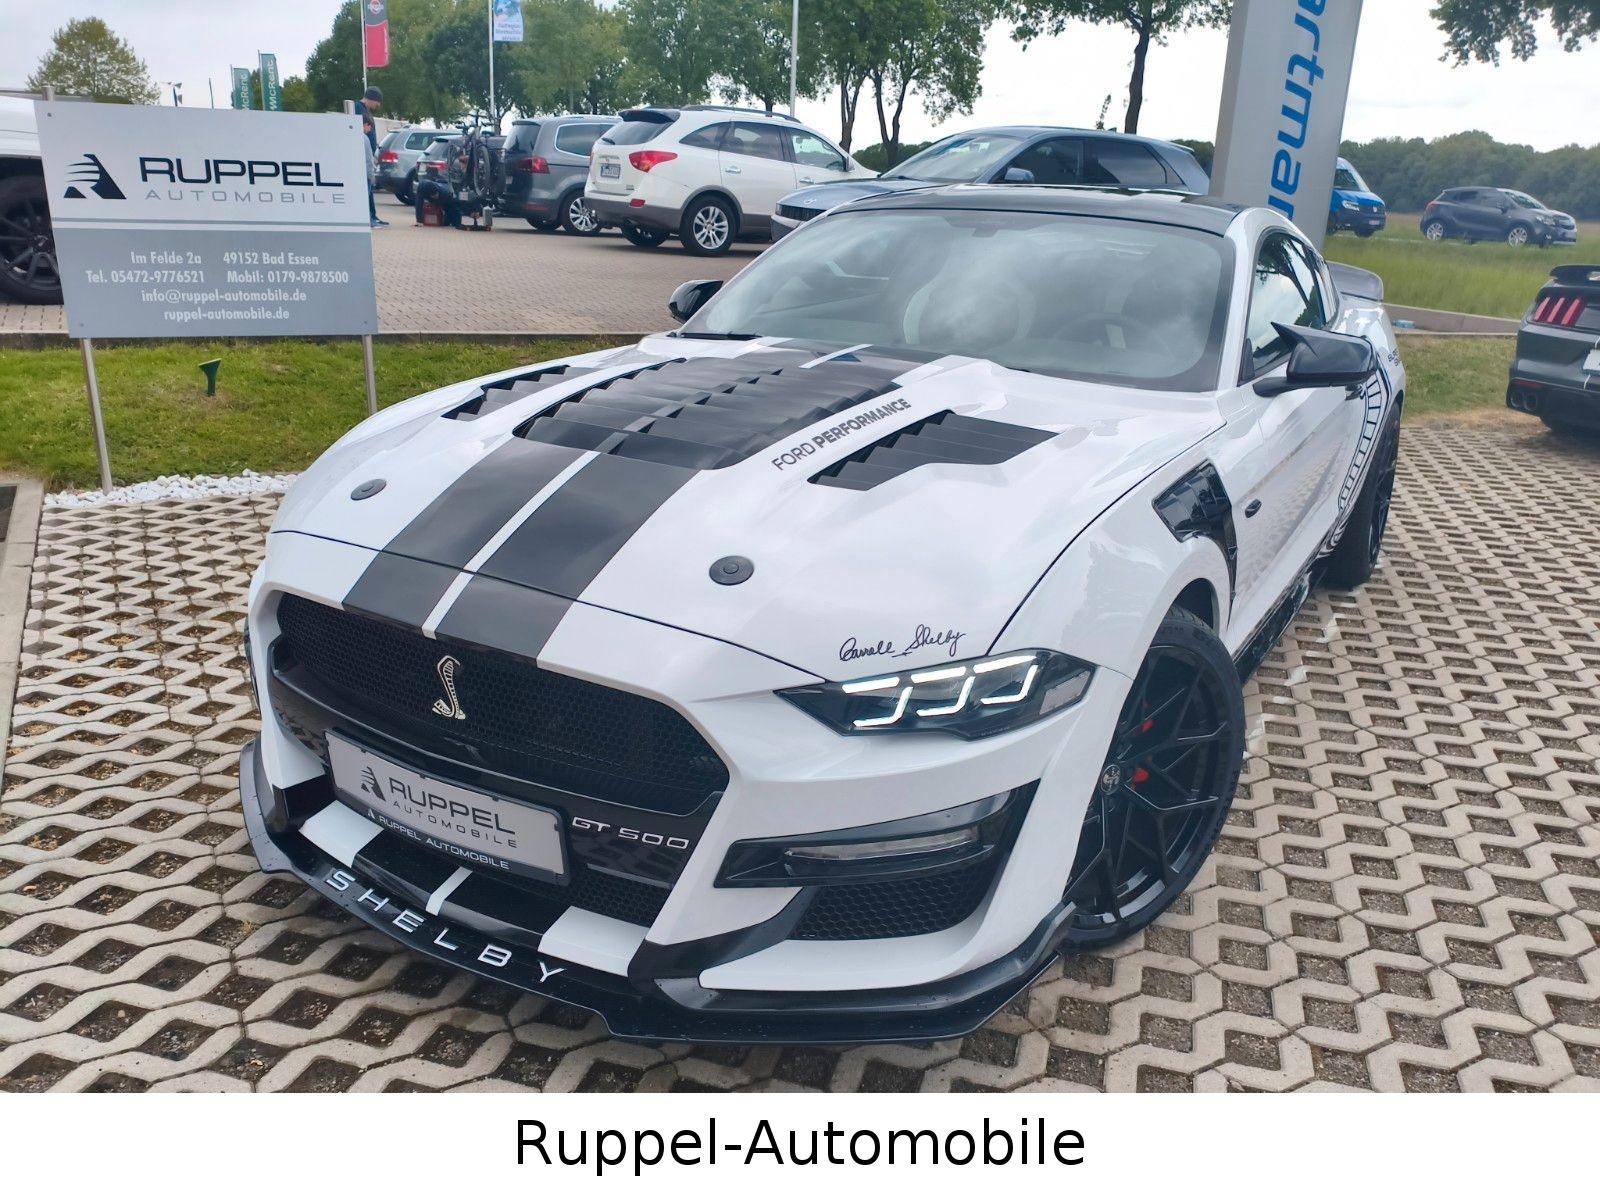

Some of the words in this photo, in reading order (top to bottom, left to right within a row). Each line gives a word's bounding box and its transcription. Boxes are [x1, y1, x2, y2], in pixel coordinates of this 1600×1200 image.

[267, 59, 278, 111] McRent
[139, 156, 345, 188] RUPPEL
[145, 189, 346, 205] AUTOMOBILE
[130, 252, 147, 264] Im
[150, 252, 184, 265] Felde
[187, 252, 202, 264] 2a
[223, 252, 259, 265] 49152
[262, 253, 285, 265] Bad
[288, 253, 319, 265] Essen
[86, 270, 108, 283] Tel.
[111, 270, 205, 283] 05472-9776521
[227, 271, 264, 284] Mobil:
[267, 271, 349, 284] 0179-9878500
[141, 289, 307, 304] info@ruppel-automobile.de
[164, 307, 290, 322] ruppel-automobile.de
[771, 442, 817, 471] FORD
[812, 398, 912, 449] PERFORMANCE
[388, 776, 517, 836] RUPPEL
[393, 800, 518, 849] AUTOMOBILE
[571, 817, 611, 833] GT
[617, 829, 690, 850] 500
[379, 815, 423, 842] RUPPEL
[426, 837, 510, 870] AUTOMOBILE
[326, 869, 565, 984] SHELBY
